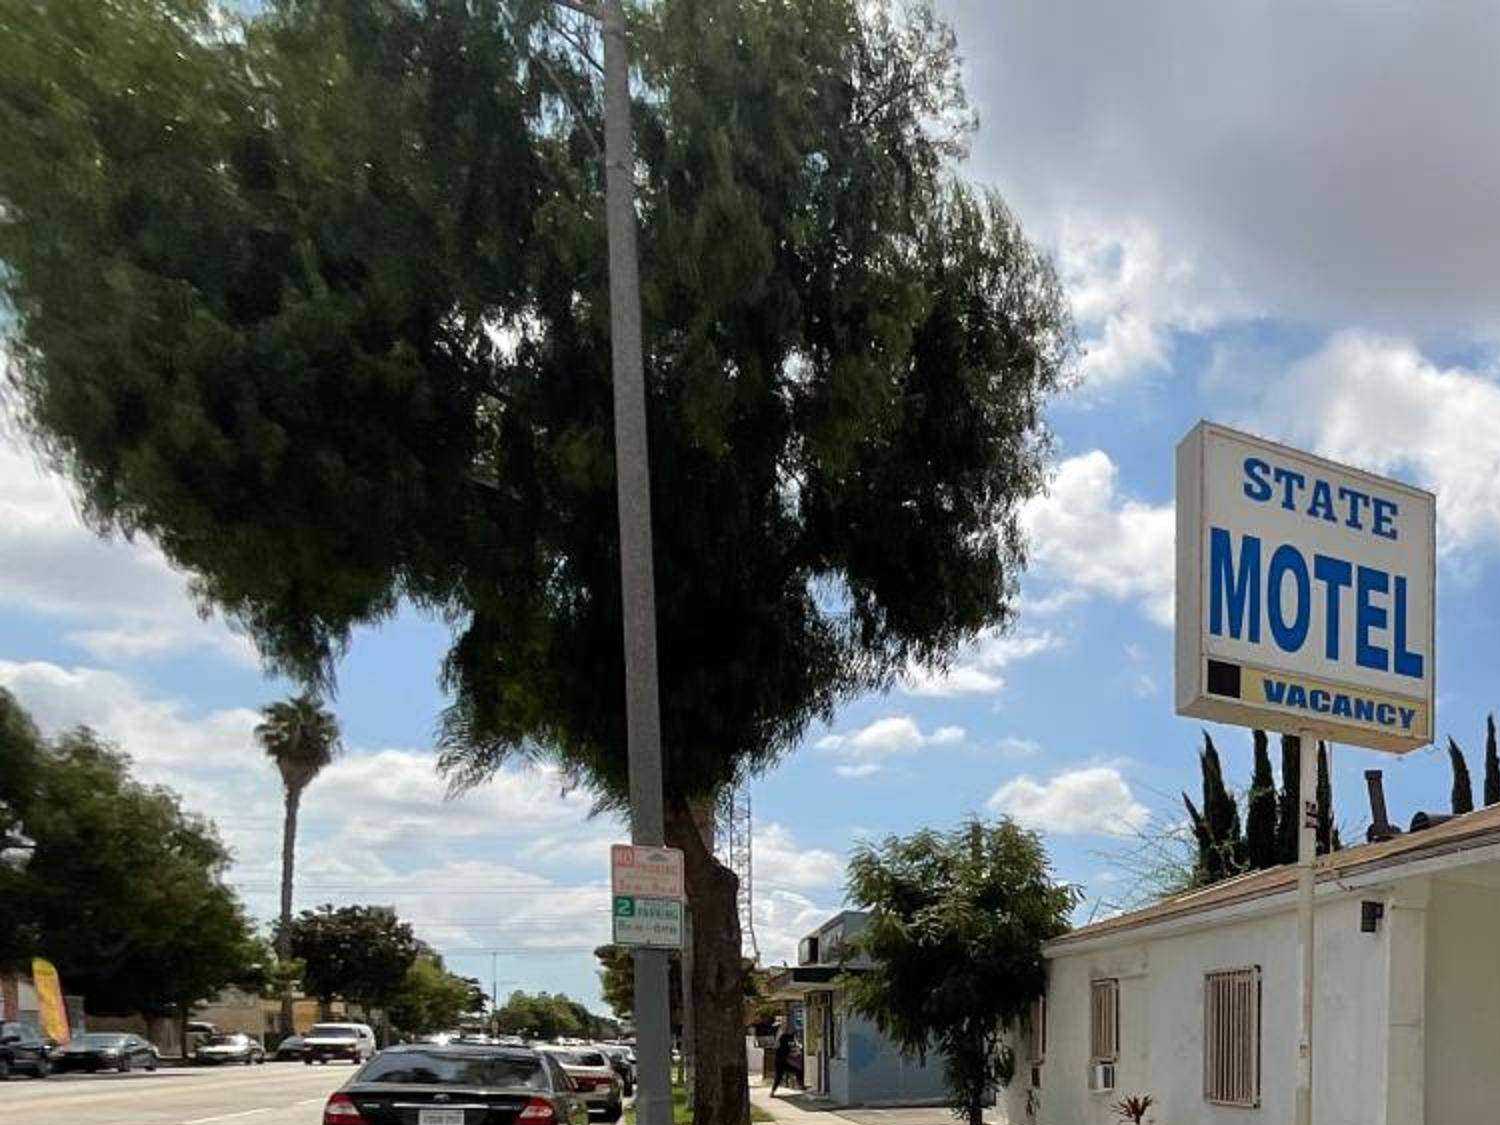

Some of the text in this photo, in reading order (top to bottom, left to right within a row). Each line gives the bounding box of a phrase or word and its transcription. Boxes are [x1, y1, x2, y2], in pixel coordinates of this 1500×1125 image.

[1243, 458, 1398, 540] STATE
[1210, 527, 1423, 679] MOTEL
[1264, 679, 1415, 729] VACANCY
[617, 899, 631, 914] 2
